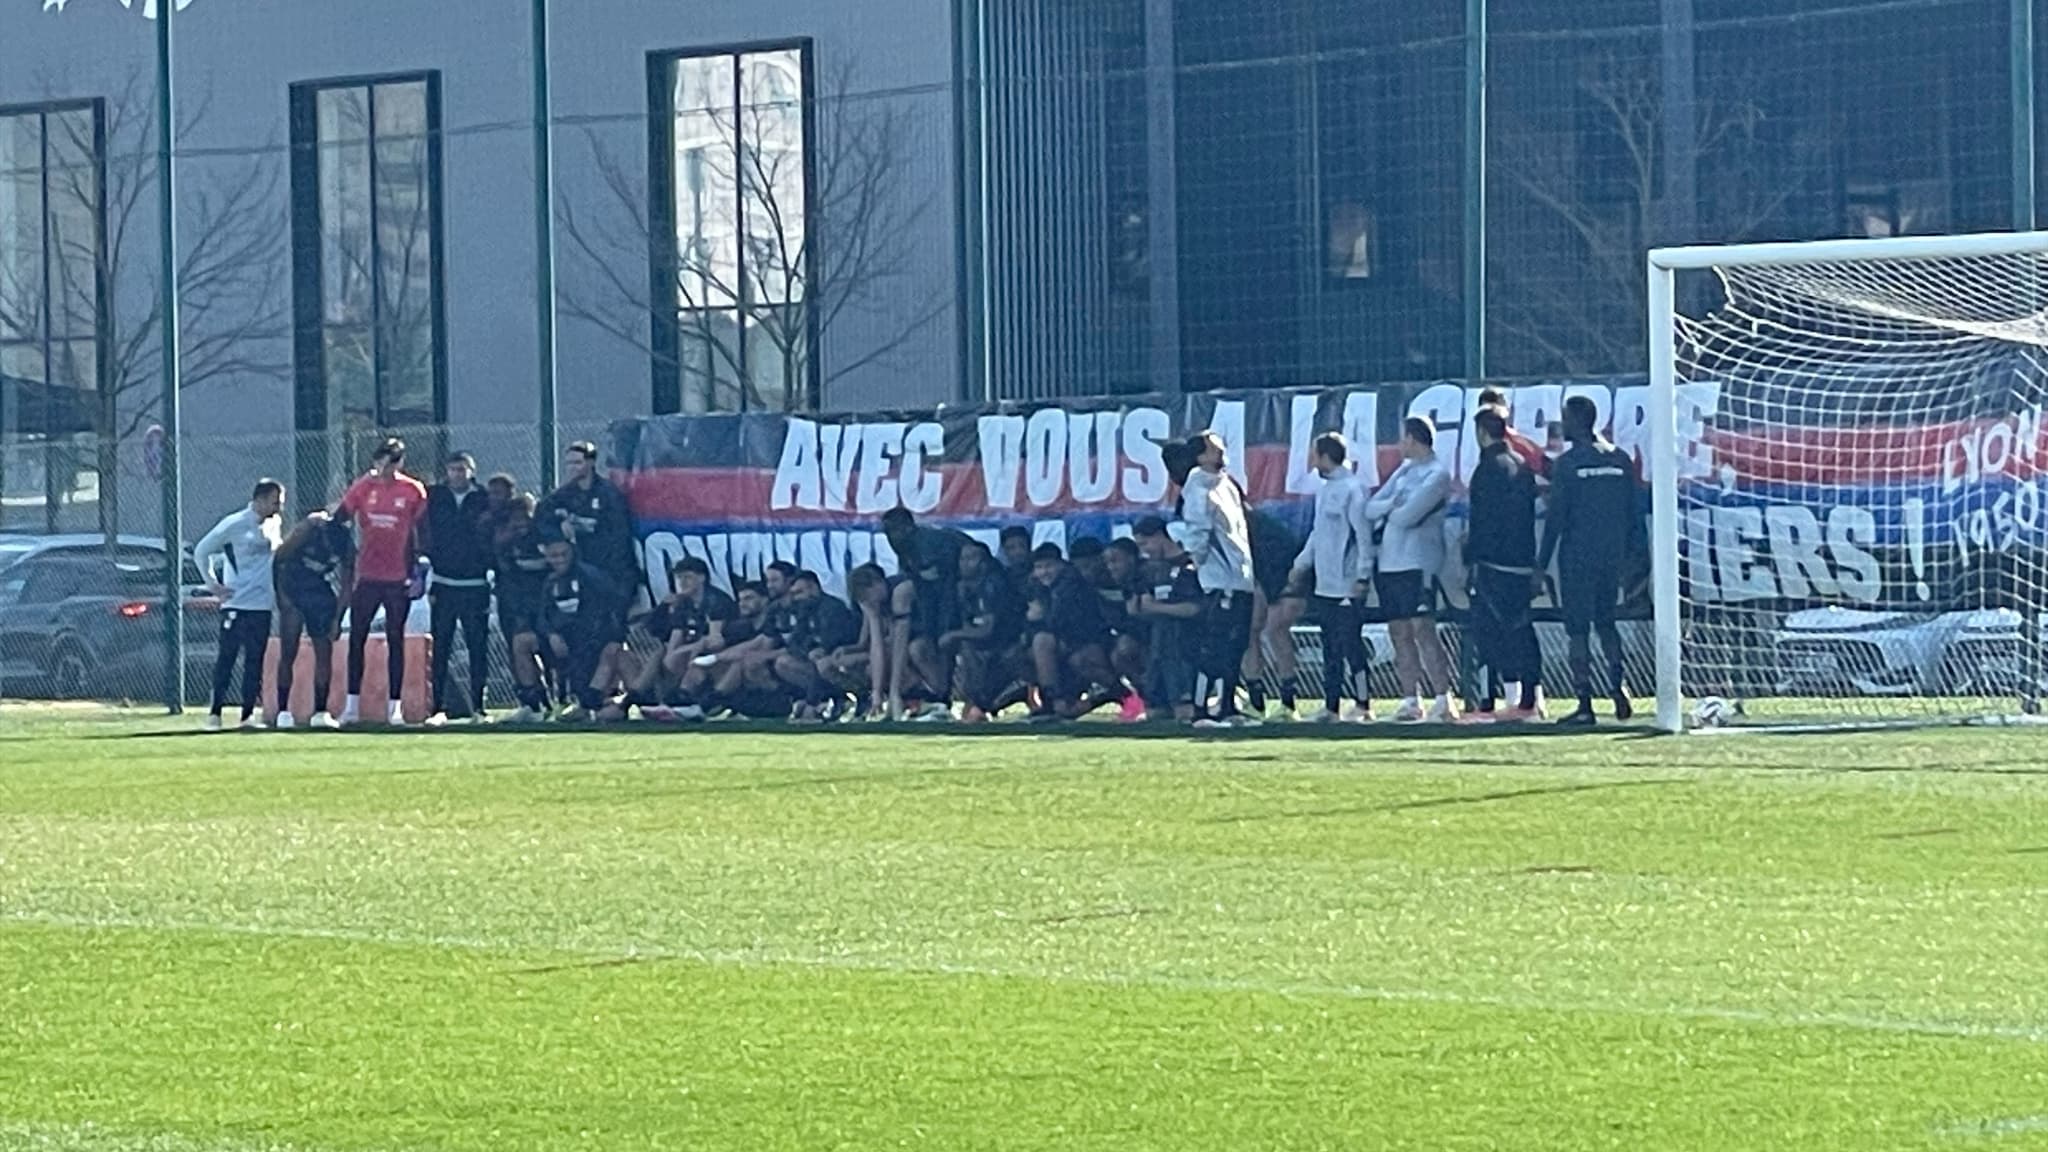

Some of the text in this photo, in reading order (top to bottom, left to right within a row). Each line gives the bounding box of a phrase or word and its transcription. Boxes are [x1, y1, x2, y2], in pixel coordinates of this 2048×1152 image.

[771, 417, 945, 515] AVEC
[978, 407, 1171, 509] VOUS
[1286, 391, 1380, 495] LA
[1942, 403, 2042, 495] LYON
[1953, 477, 2040, 567] 1950
